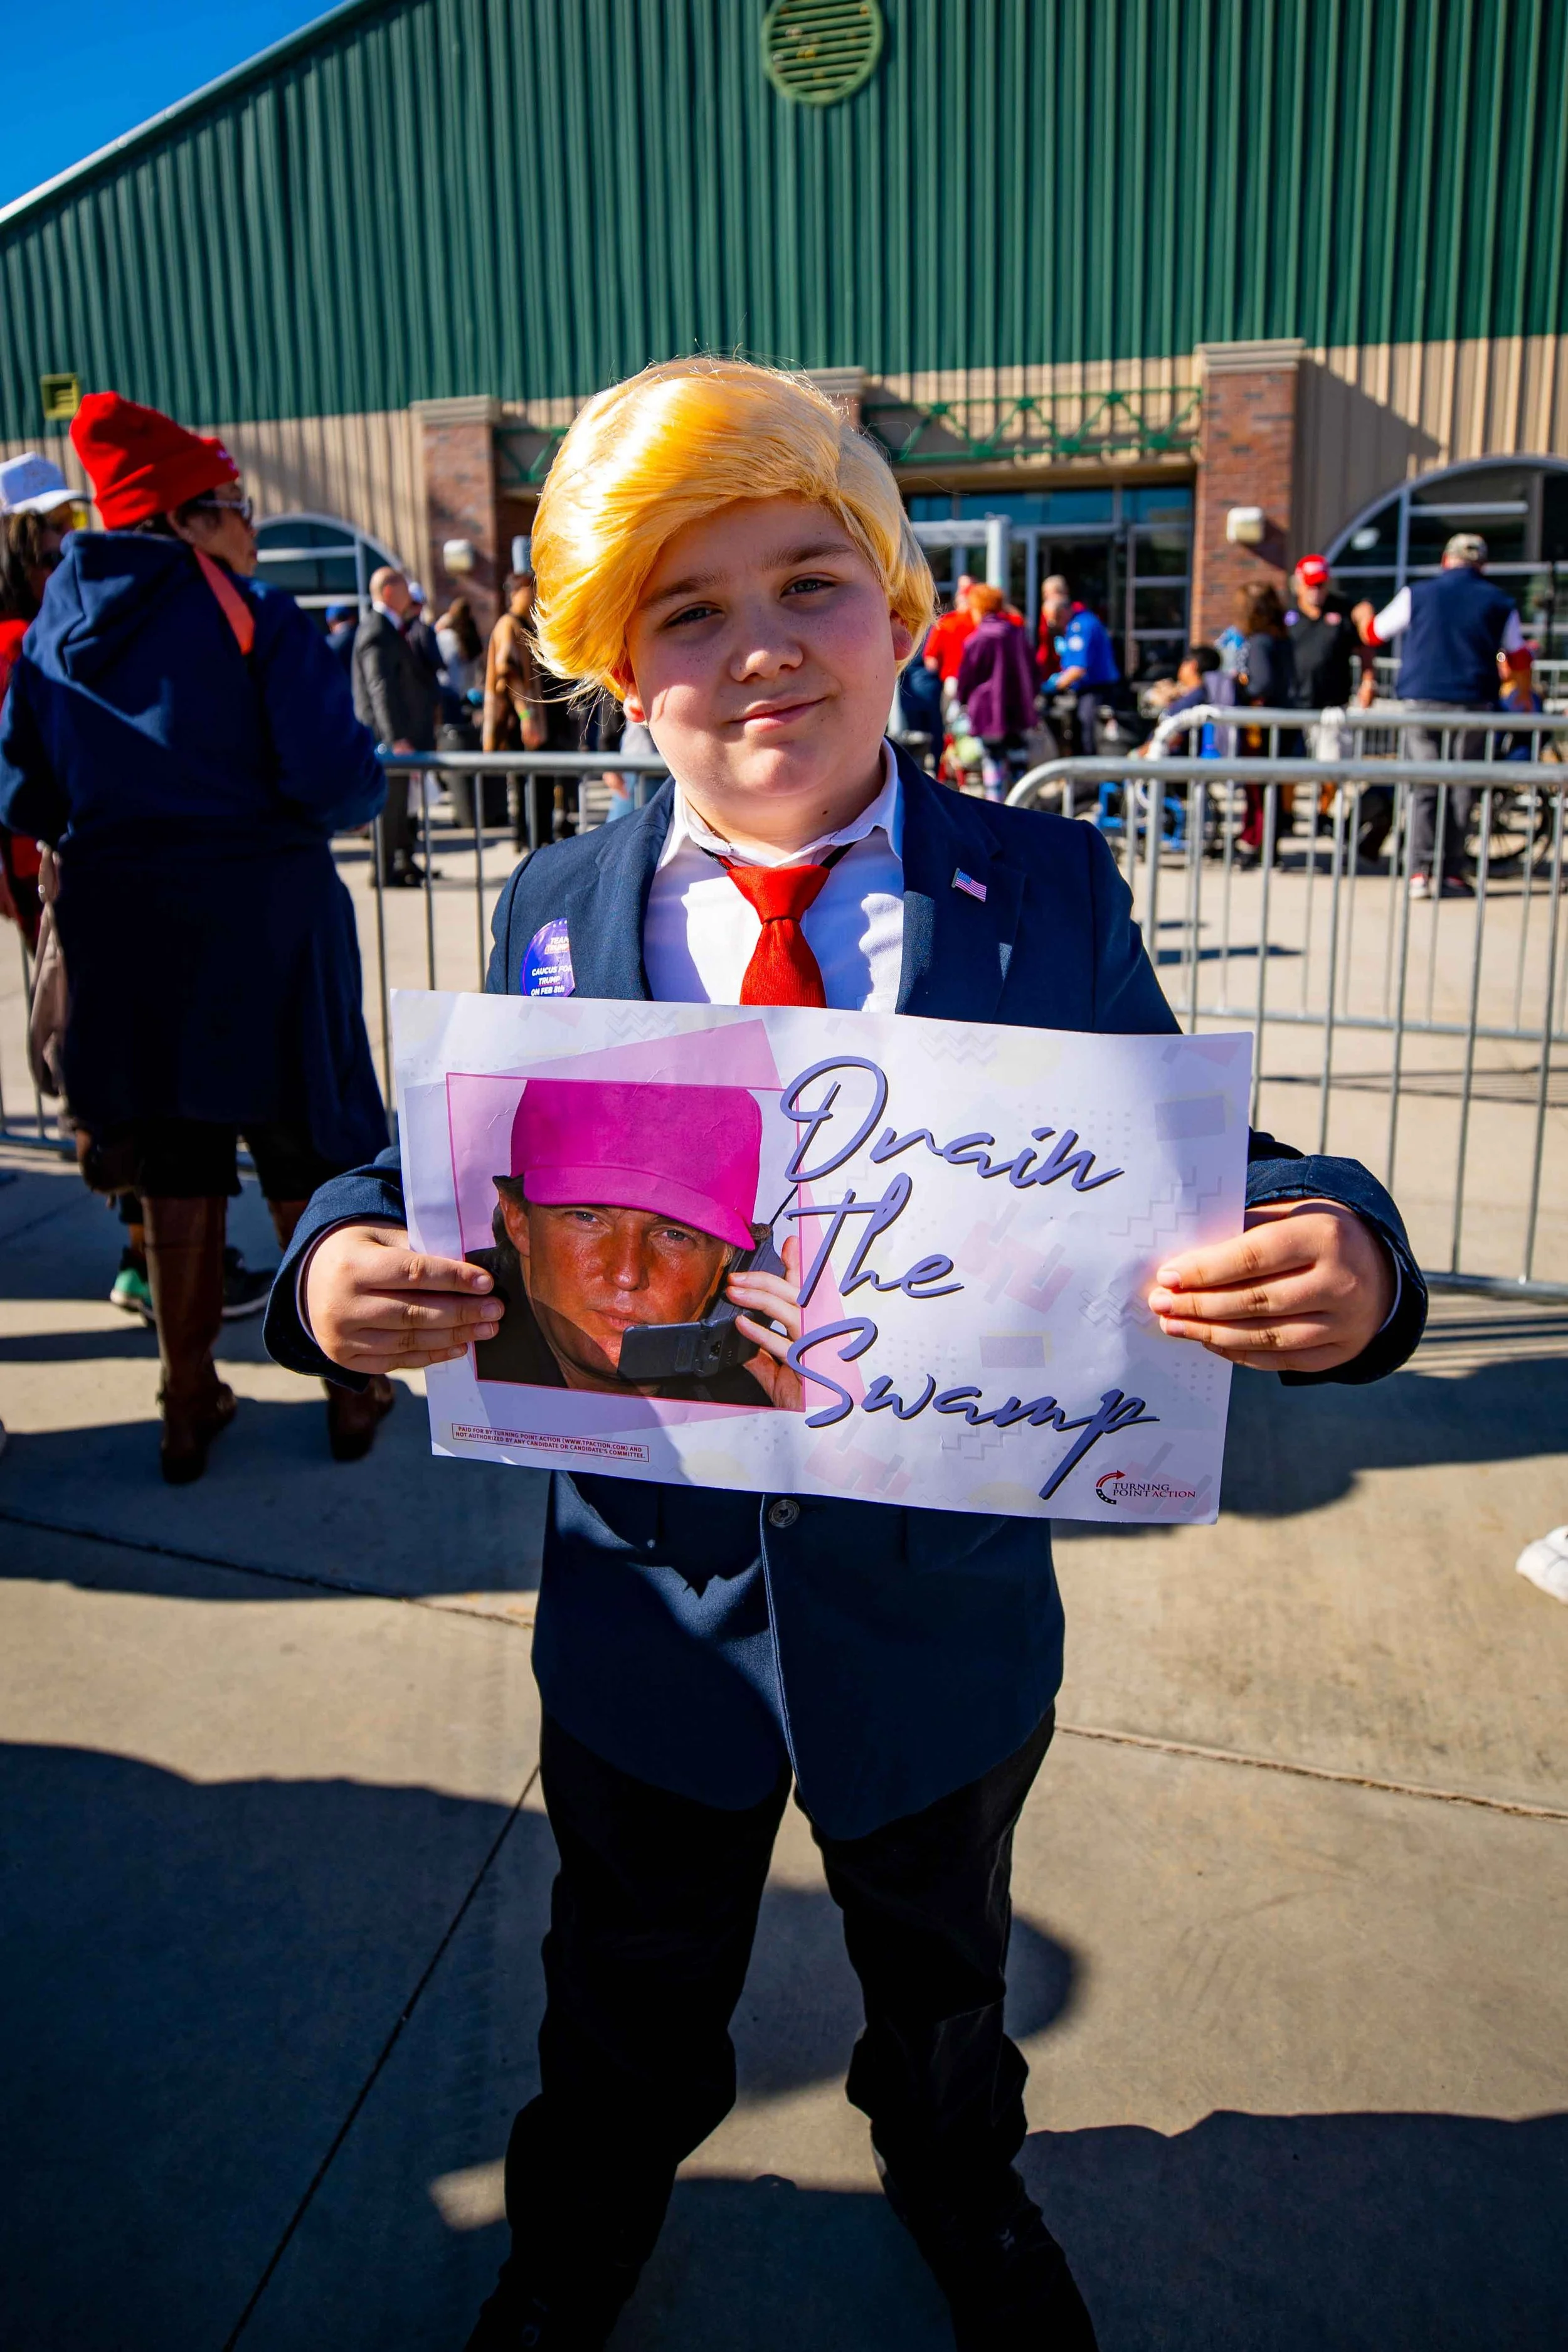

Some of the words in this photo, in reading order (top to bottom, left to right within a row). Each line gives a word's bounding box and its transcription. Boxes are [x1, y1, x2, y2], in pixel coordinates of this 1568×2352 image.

[531, 967, 557, 976] CAUCUS
[539, 976, 561, 985] TRUMP
[531, 988, 540, 996] ON
[541, 987, 553, 995] FEB
[780, 1056, 1125, 1192] Drain
[783, 1172, 965, 1308] The
[787, 1316, 1161, 1500] Swamp
[469, 1433, 504, 1442] AUTHORIZED
[526, 1440, 558, 1449] CANDIDATE
[569, 1445, 608, 1454] CANDIDATE'S
[609, 1450, 645, 1459] COMMITTEE.
[494, 1430, 519, 1438] TURNING
[562, 1438, 628, 1451] (WWW.TPACTION.COM)
[1113, 1482, 1170, 1491] TURNING
[1113, 1489, 1151, 1497] POINT
